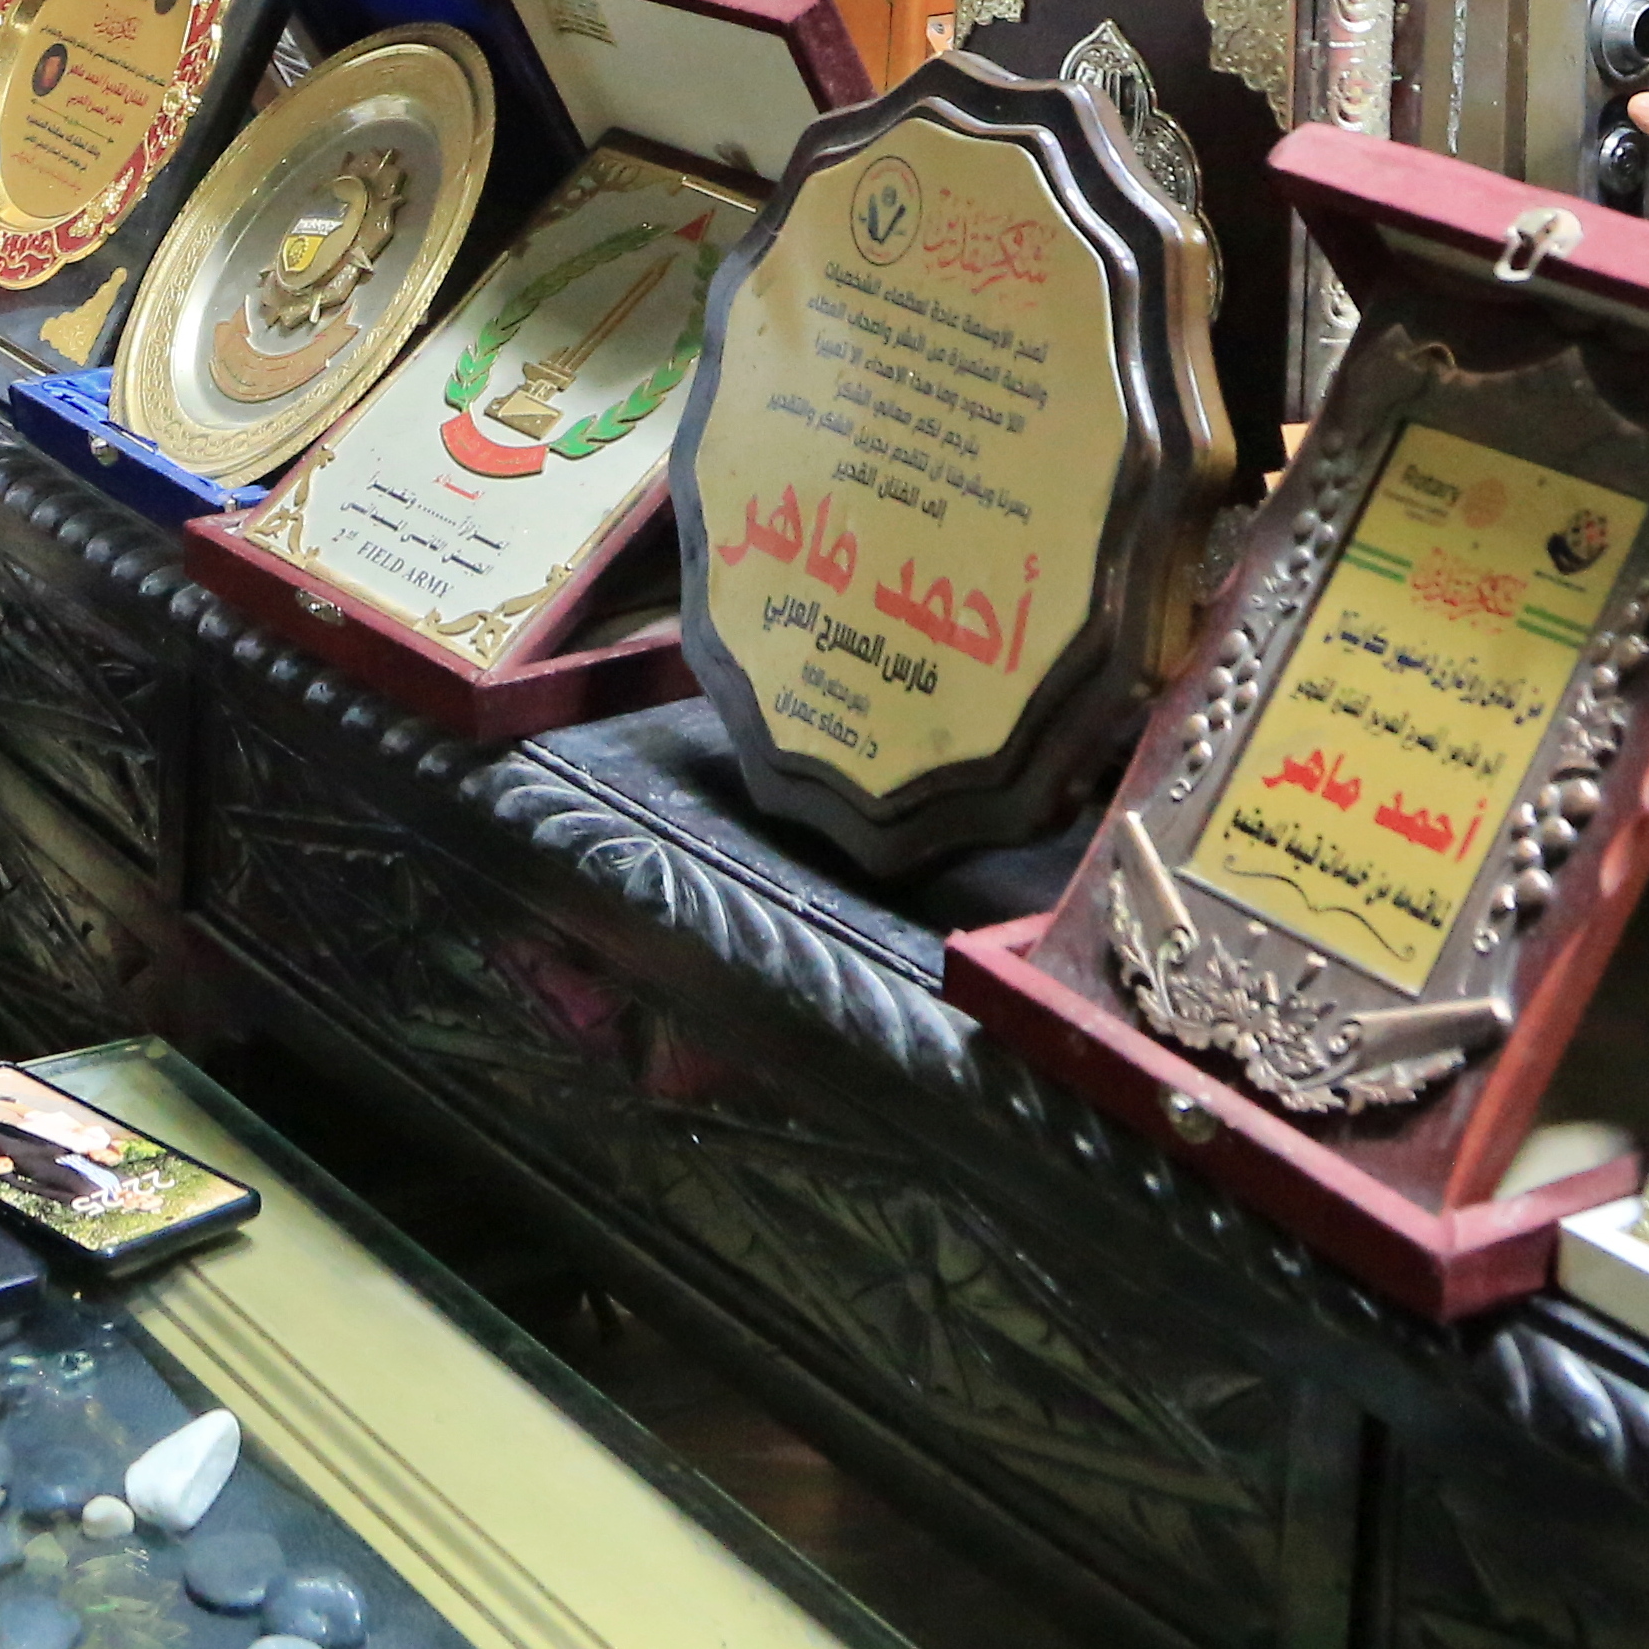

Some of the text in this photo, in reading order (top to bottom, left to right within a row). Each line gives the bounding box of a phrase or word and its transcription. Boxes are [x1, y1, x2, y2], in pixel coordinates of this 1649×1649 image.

[831, 461, 879, 492] القدير
[875, 469, 923, 508] الفنان
[356, 540, 405, 573] FIELD
[400, 566, 454, 599] ARMY
[440, 548, 493, 576] الجيش
[717, 486, 1041, 682] أحمد ماهر
[762, 594, 822, 651] العربي
[812, 609, 886, 673] المسرح
[879, 641, 938, 695] فارس
[1261, 749, 1486, 861] أحمد ماهر
